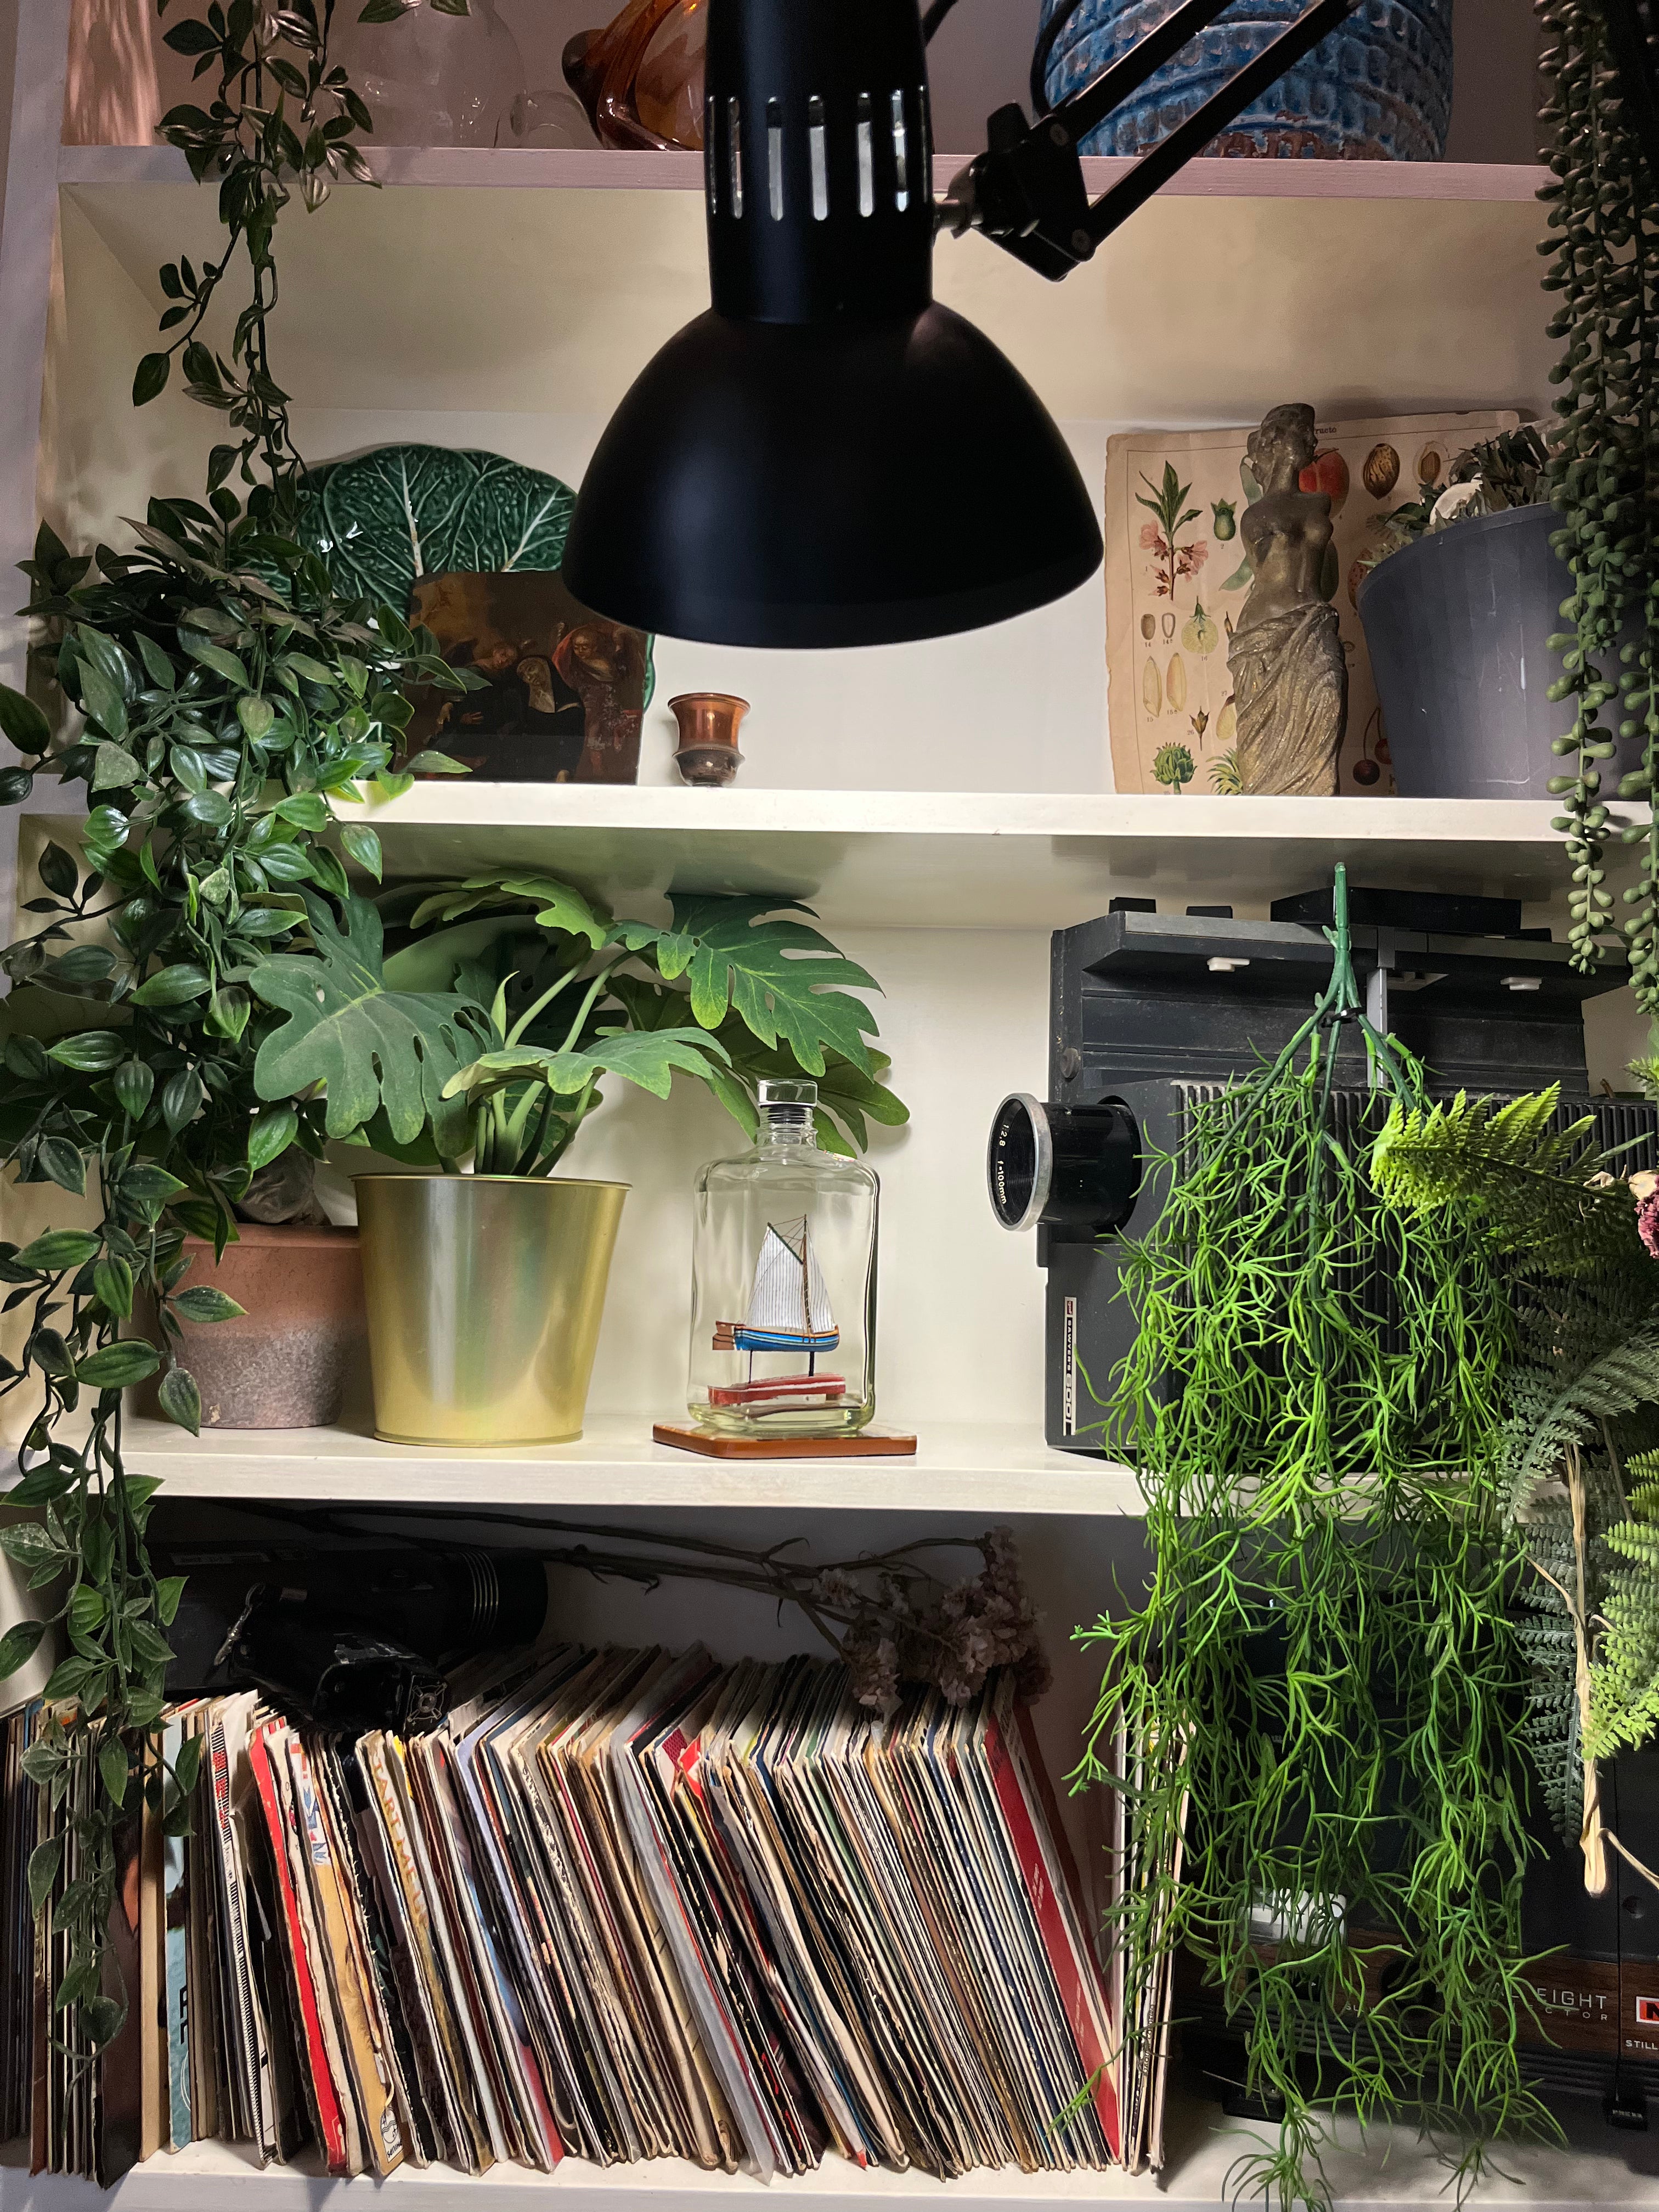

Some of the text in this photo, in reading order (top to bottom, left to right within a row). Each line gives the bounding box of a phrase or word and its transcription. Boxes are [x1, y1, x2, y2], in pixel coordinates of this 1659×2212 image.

[1315, 426, 1337, 435] ructo
[374, 1757, 401, 1827] TART
[1626, 2040, 1658, 2050] STILL
